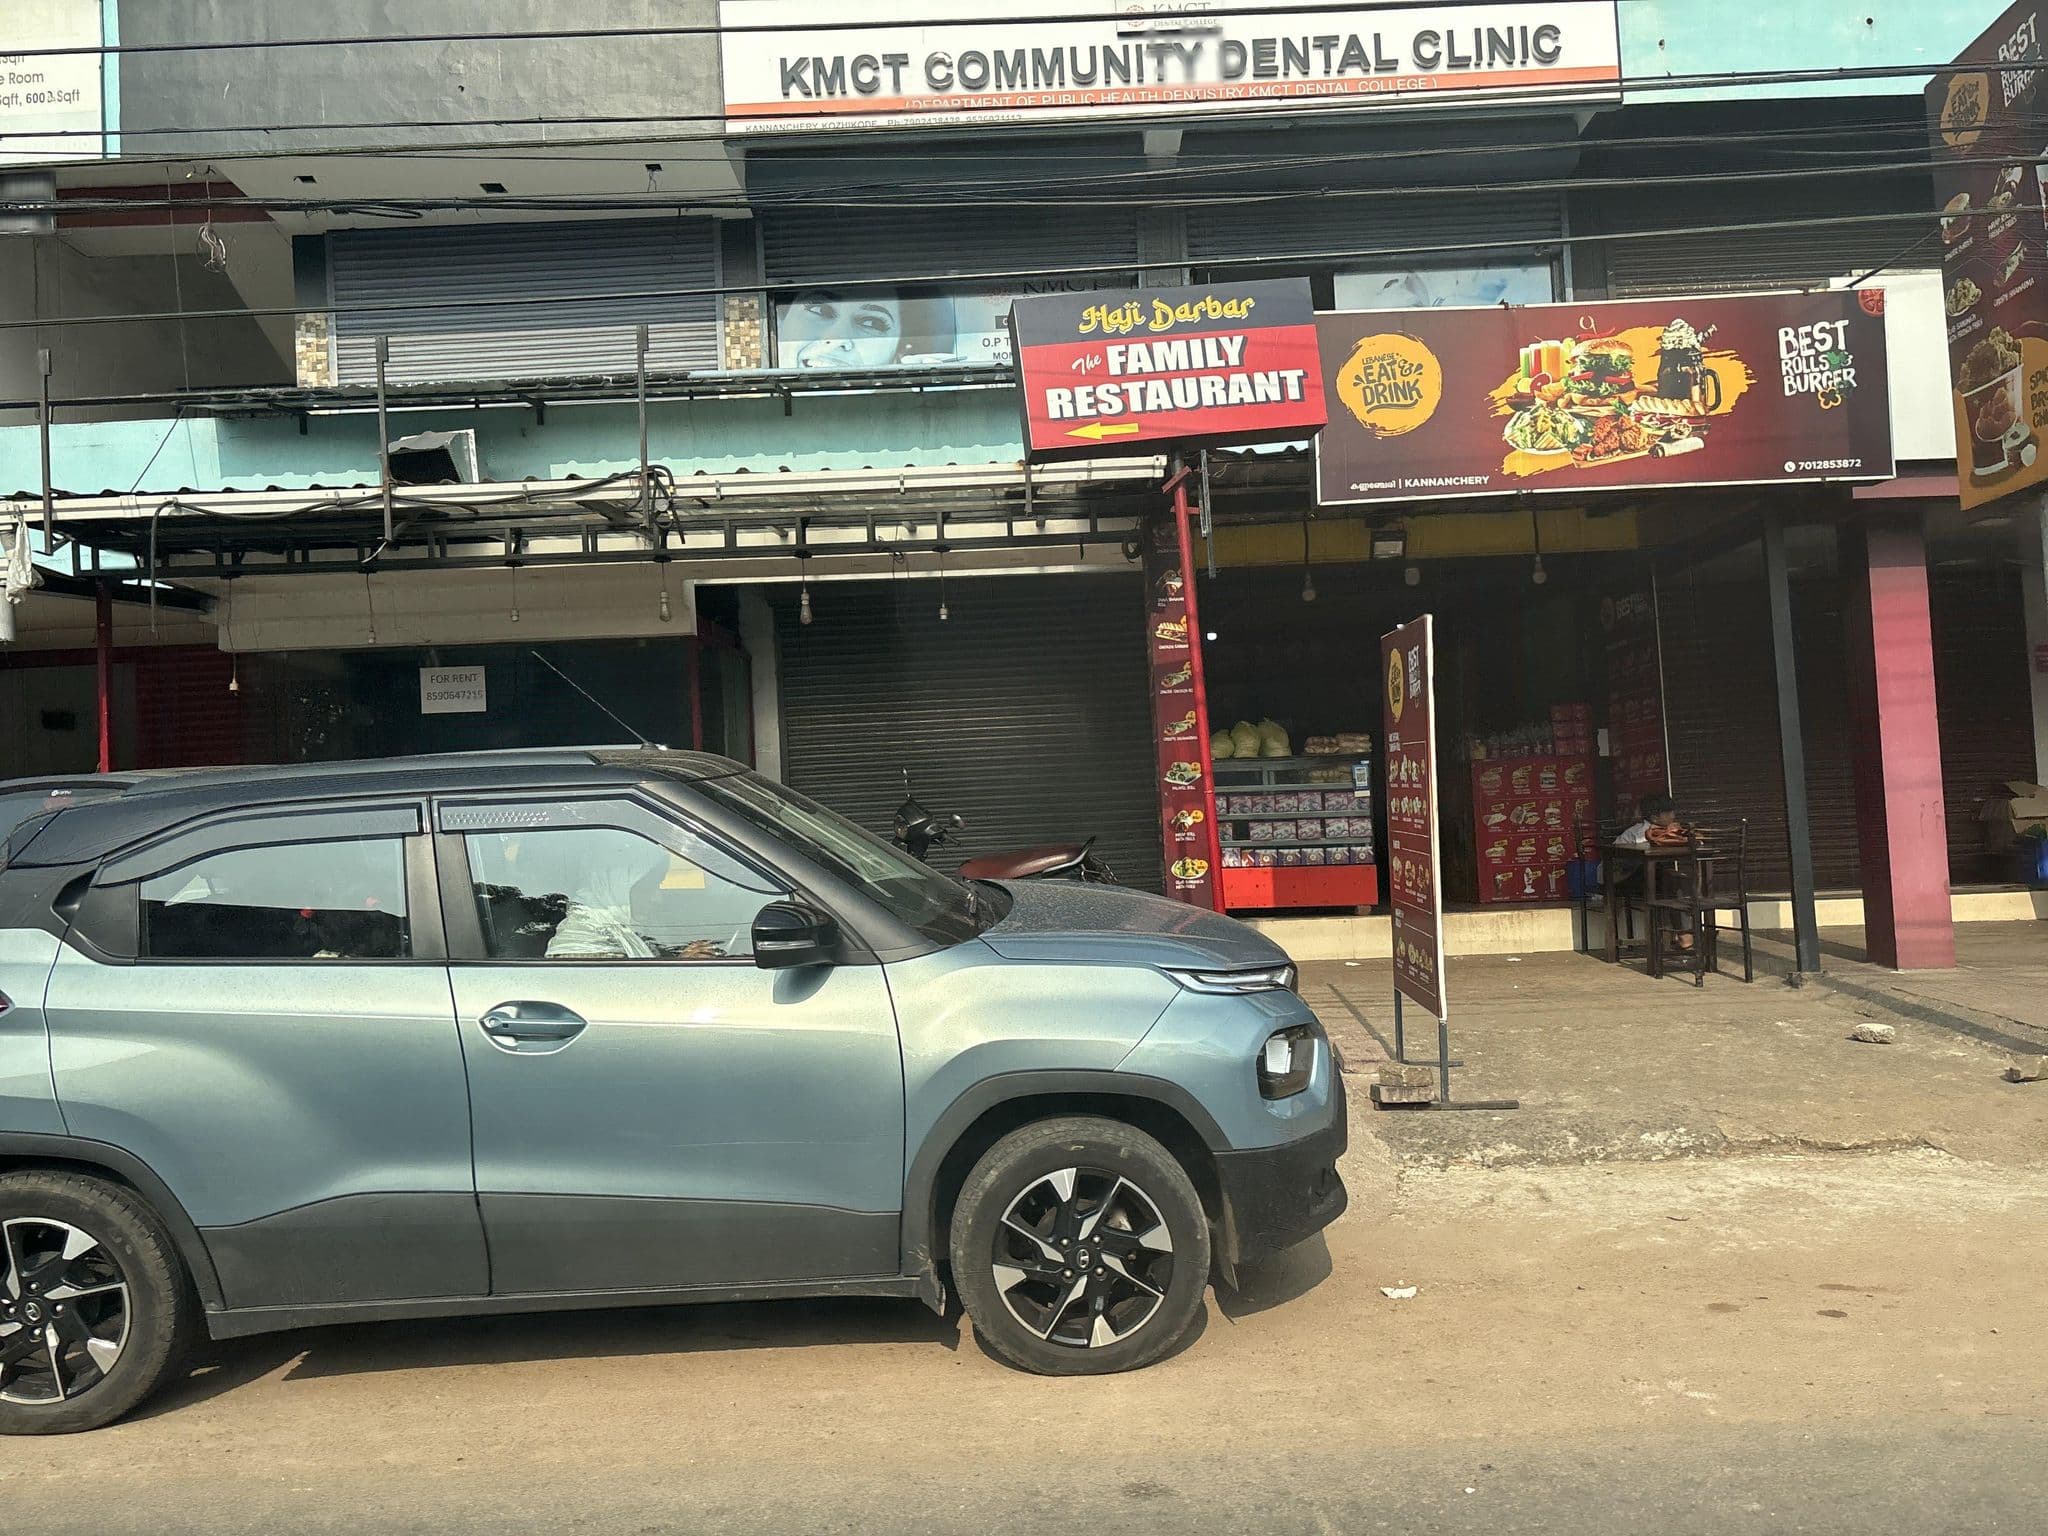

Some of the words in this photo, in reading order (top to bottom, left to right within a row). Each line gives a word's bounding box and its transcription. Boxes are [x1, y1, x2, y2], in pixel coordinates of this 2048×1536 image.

[780, 53, 909, 97] KMCT
[924, 42, 1203, 91] COMMUNITY
[1221, 33, 1399, 79] DENTAL
[1412, 24, 1562, 70] CLINIC
[9, 72, 44, 84] Room
[1163, 85, 1247, 101] DENTISTRY
[1249, 83, 1293, 97] KMCT
[1296, 81, 1351, 95] DENTAL
[1358, 78, 1427, 92] COLLEGE
[1078, 301, 1145, 334] Haji
[1149, 295, 1256, 333] Darbar
[1778, 319, 1849, 360] BEST
[1072, 354, 1102, 376] The
[1106, 335, 1246, 376] FAMILY
[1781, 354, 1830, 377] ROLLS
[1363, 359, 1398, 384] EAT
[1783, 367, 1858, 397] BURGER
[1046, 369, 1305, 420] RESTAURANT
[1362, 378, 1424, 407] DRINK
[1798, 458, 1862, 471] 7012853872
[1404, 475, 1490, 488] KANNANCHERY
[430, 674, 450, 684] FOR
[452, 673, 478, 683] RENT
